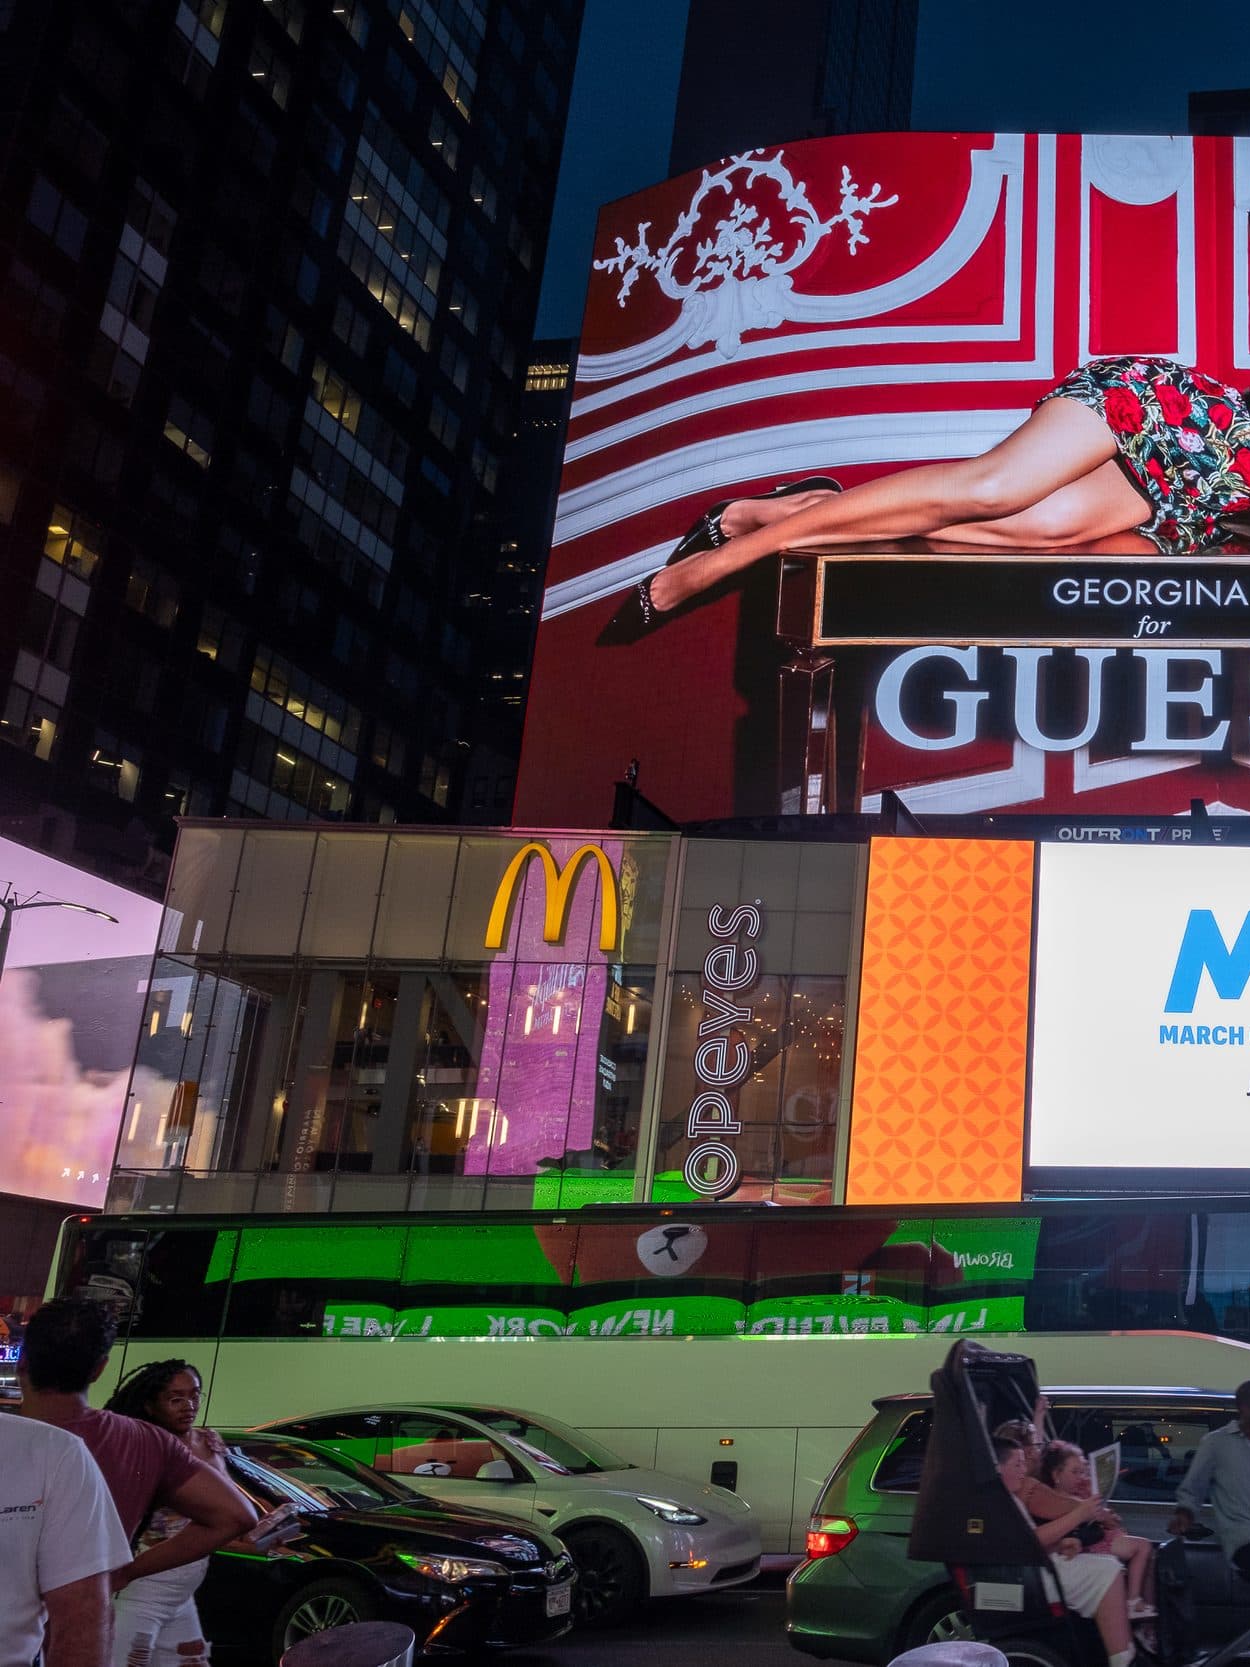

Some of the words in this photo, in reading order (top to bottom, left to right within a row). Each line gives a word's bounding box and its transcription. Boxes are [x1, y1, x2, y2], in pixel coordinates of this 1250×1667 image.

[1053, 578, 1249, 606] GEORGINA
[1133, 615, 1171, 638] for
[1058, 827, 1161, 841] OUTFRONT
[1172, 829, 1222, 841] PRE
[1159, 1025, 1244, 1045] MARCH
